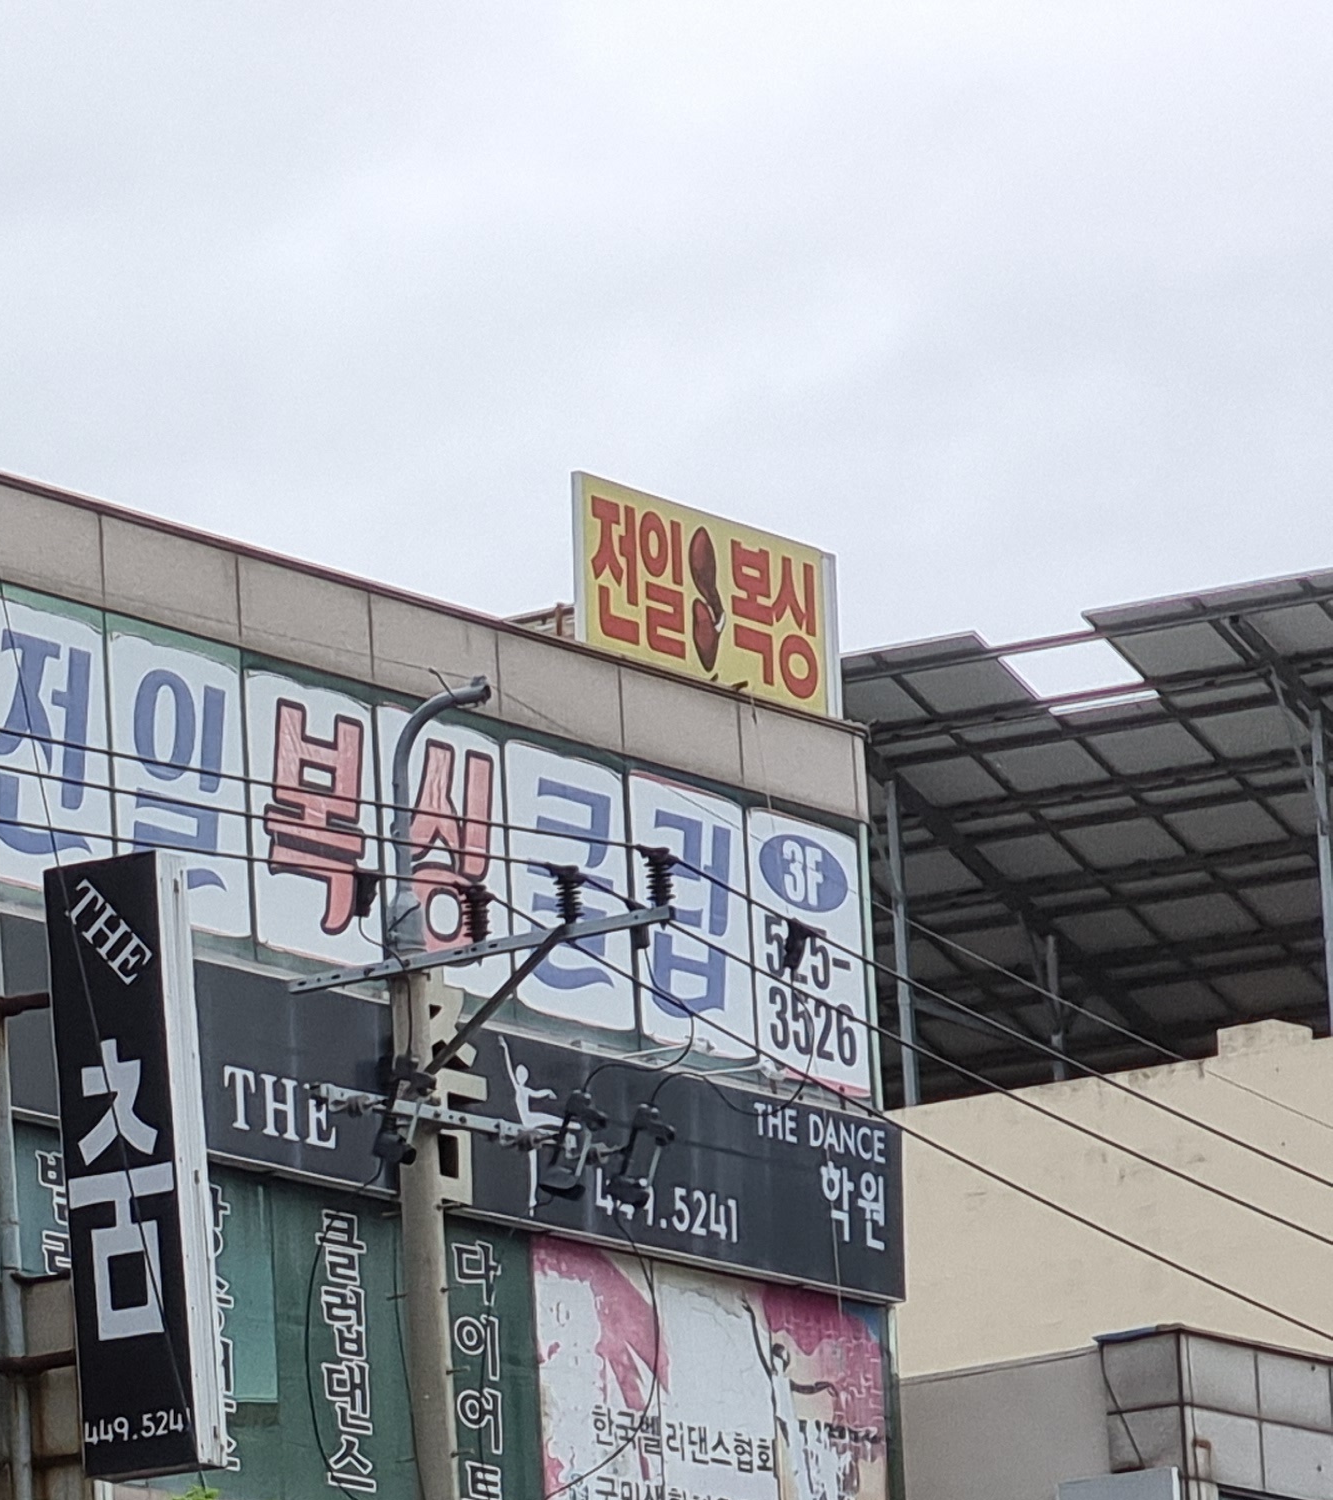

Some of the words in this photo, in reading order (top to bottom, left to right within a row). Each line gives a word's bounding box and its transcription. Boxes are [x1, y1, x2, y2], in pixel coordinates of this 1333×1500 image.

[590, 494, 687, 660] 전일
[729, 538, 819, 700] 복싱
[781, 840, 826, 909] 3F
[67, 878, 153, 985] THE
[769, 989, 858, 1069] 3526
[223, 1063, 337, 1149] THE
[753, 1101, 798, 1146] THE
[808, 1122, 886, 1165] DANCE
[68, 1039, 174, 1342] 춤
[595, 1168, 739, 1244] 4.5241
[819, 1161, 886, 1252] 학원
